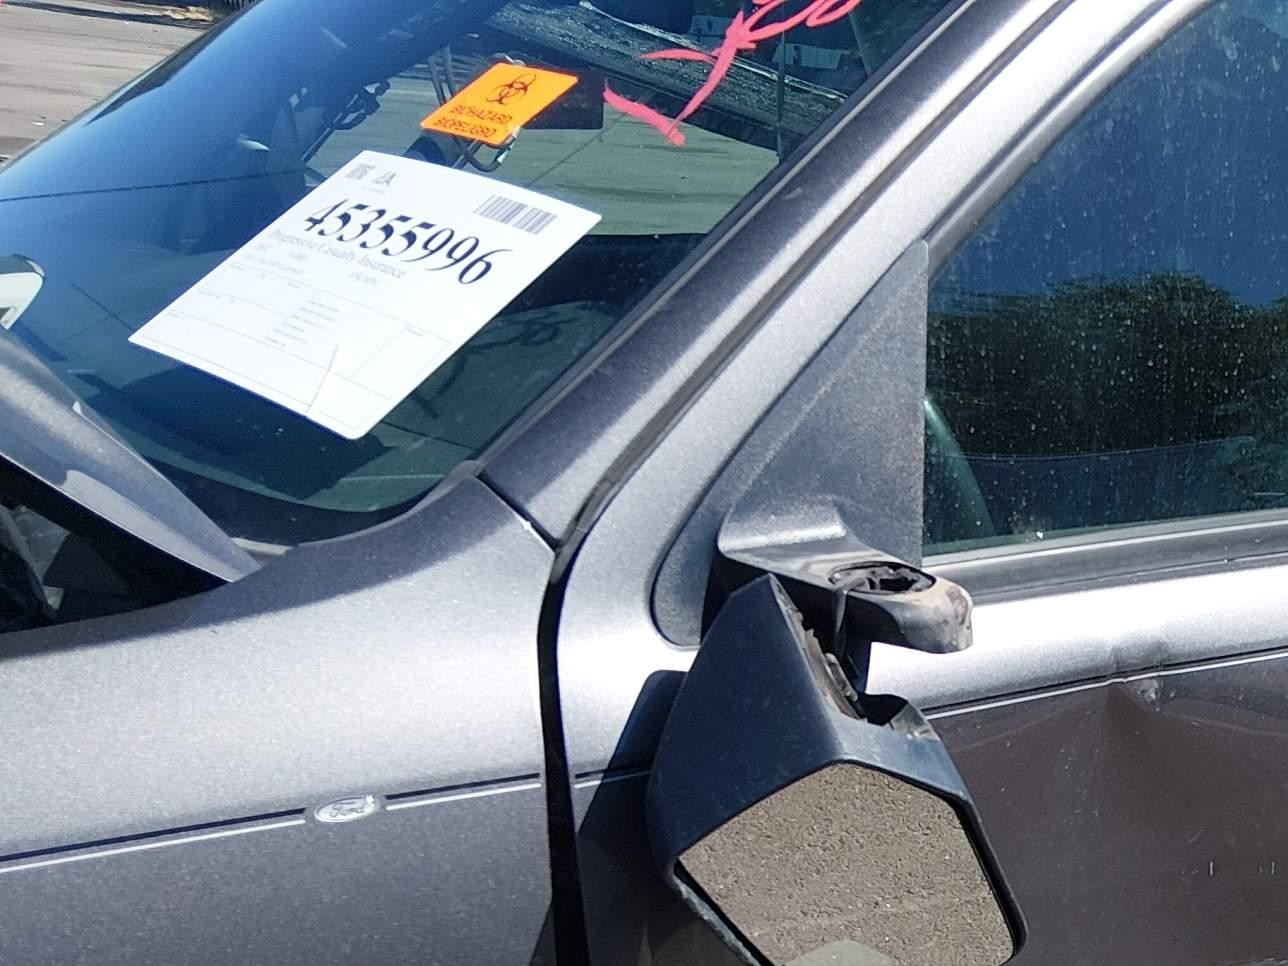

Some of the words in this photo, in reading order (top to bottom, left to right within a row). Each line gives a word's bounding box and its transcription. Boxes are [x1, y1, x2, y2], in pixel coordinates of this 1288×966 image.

[449, 104, 513, 126] BIOHAZARD
[433, 116, 498, 139] BIOPELIGRO
[304, 198, 514, 285] 45355996
